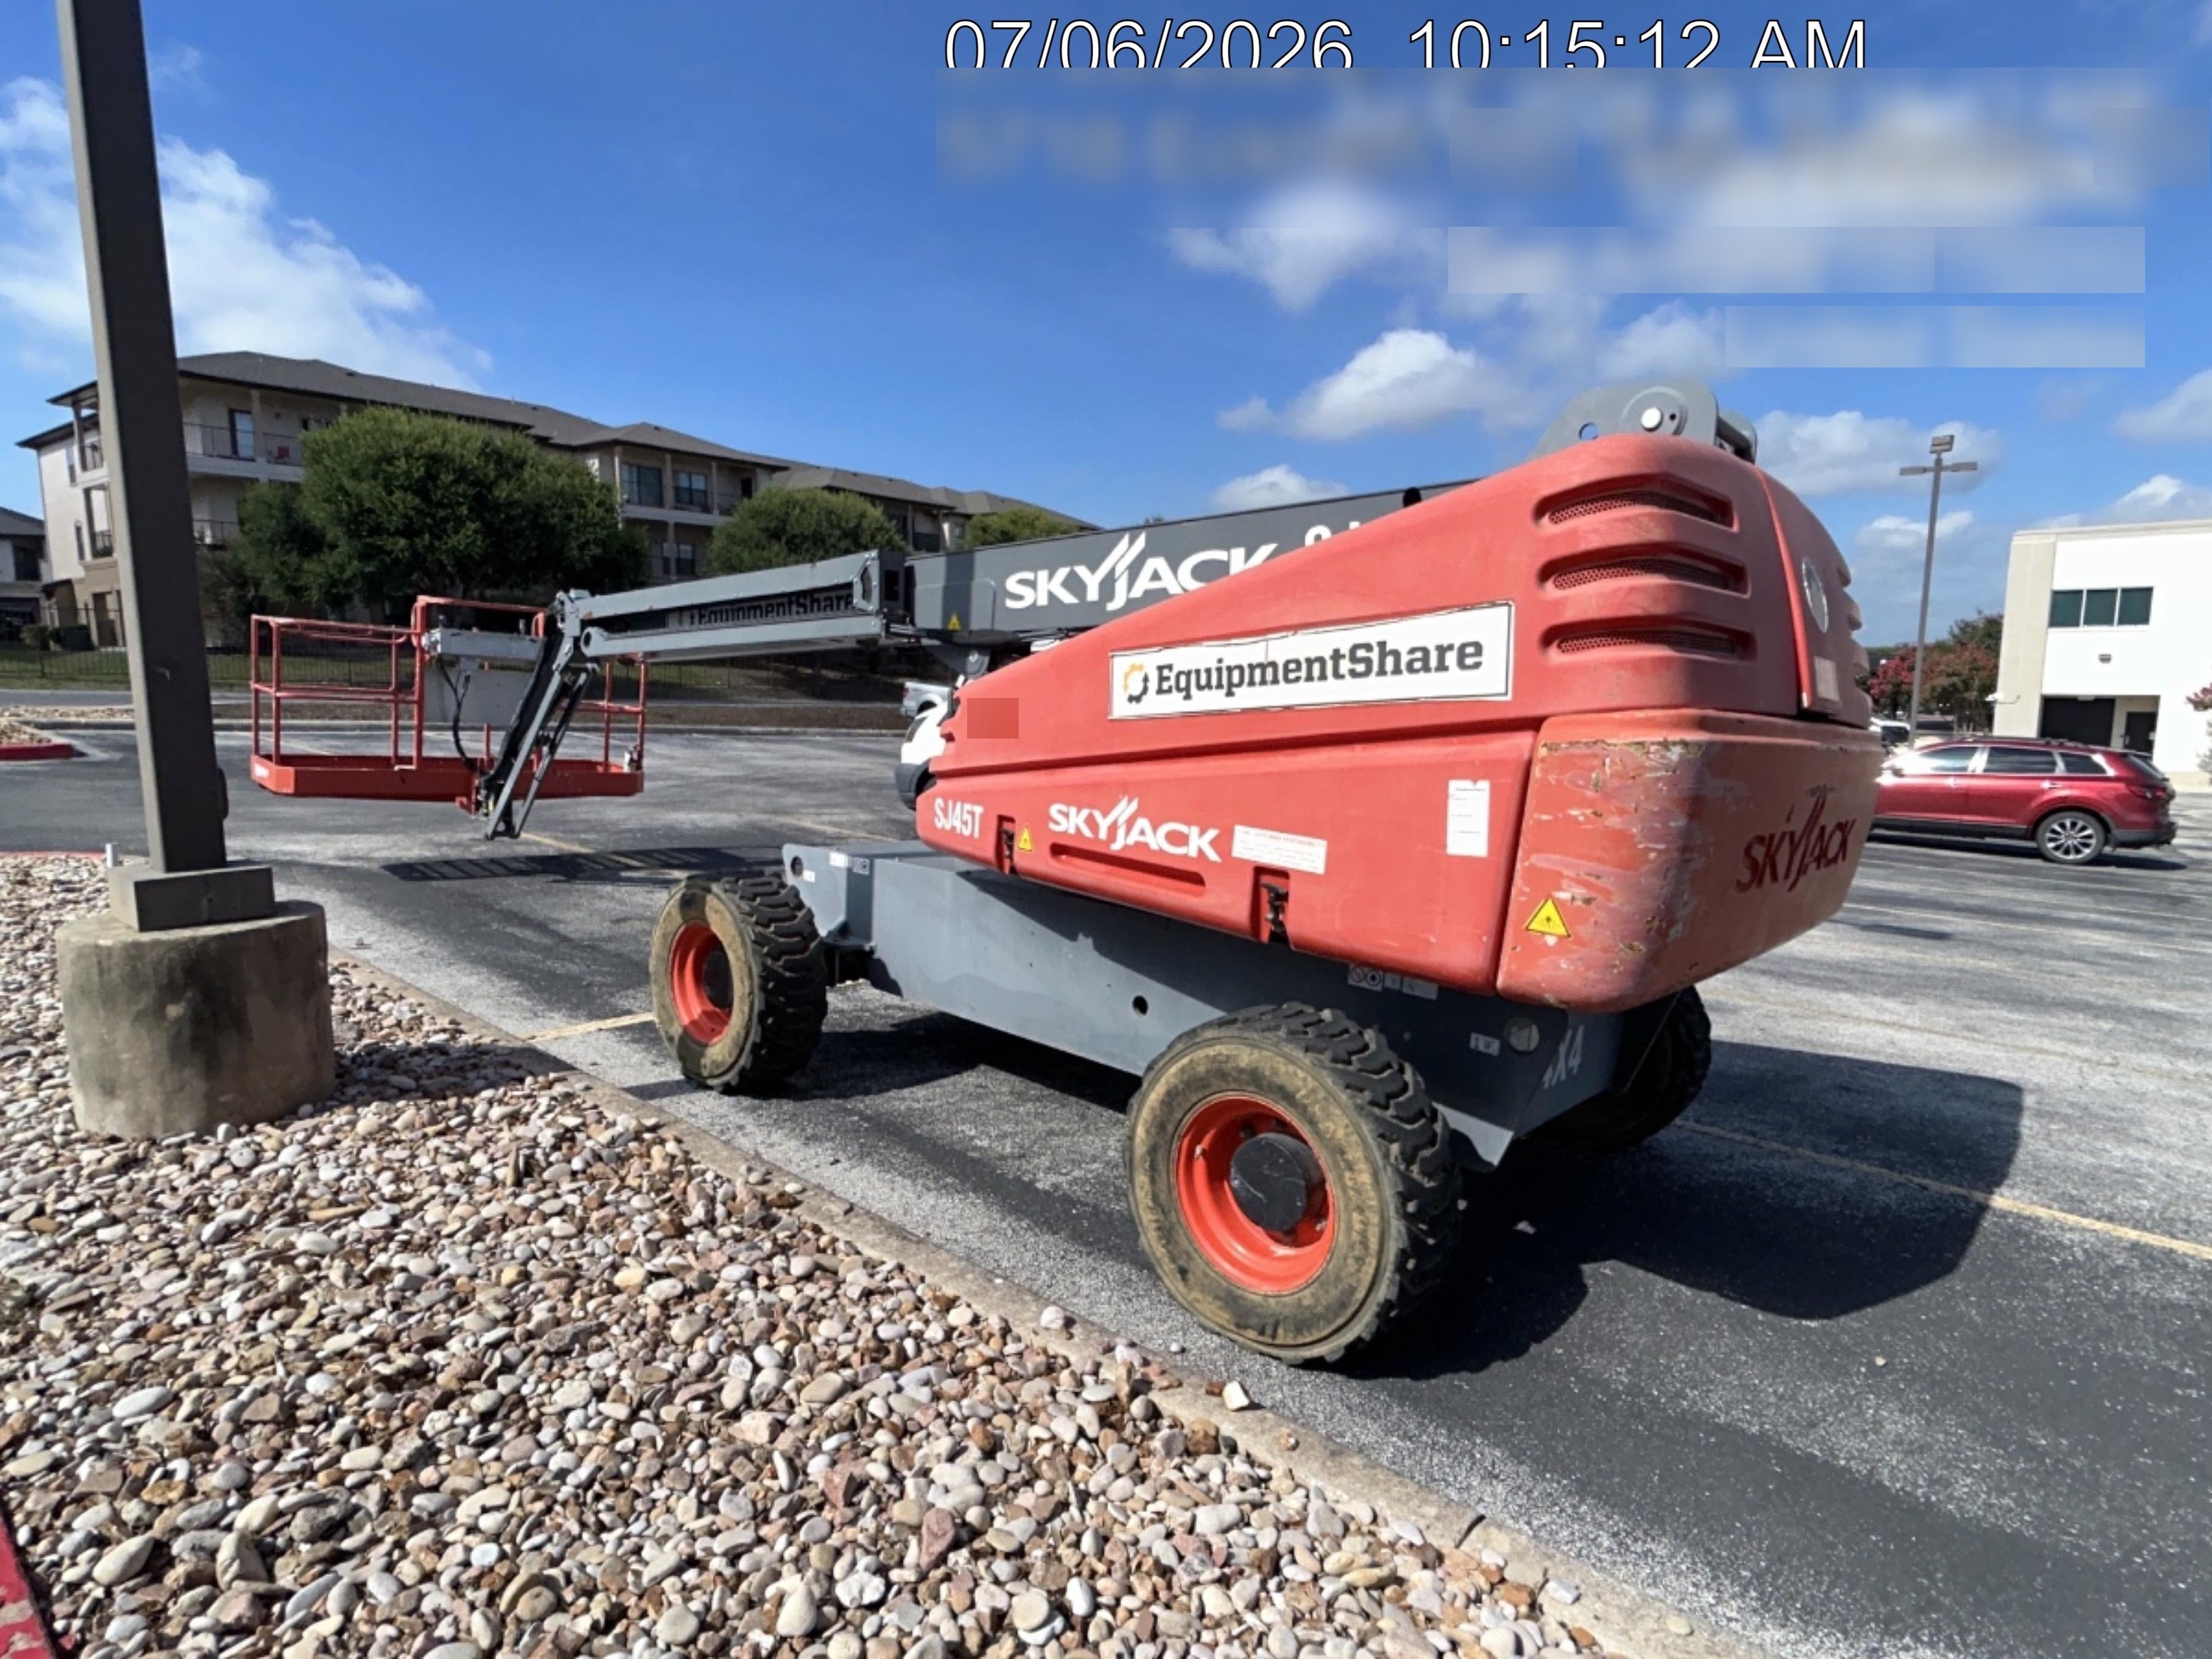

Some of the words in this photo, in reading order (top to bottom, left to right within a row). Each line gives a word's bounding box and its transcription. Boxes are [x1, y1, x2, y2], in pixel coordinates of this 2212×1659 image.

[1005, 532, 1278, 610] SKYJACK
[1156, 640, 1484, 700] EquipmentShare
[933, 798, 984, 839] SJ45T
[1048, 796, 1222, 863] SKYJACK
